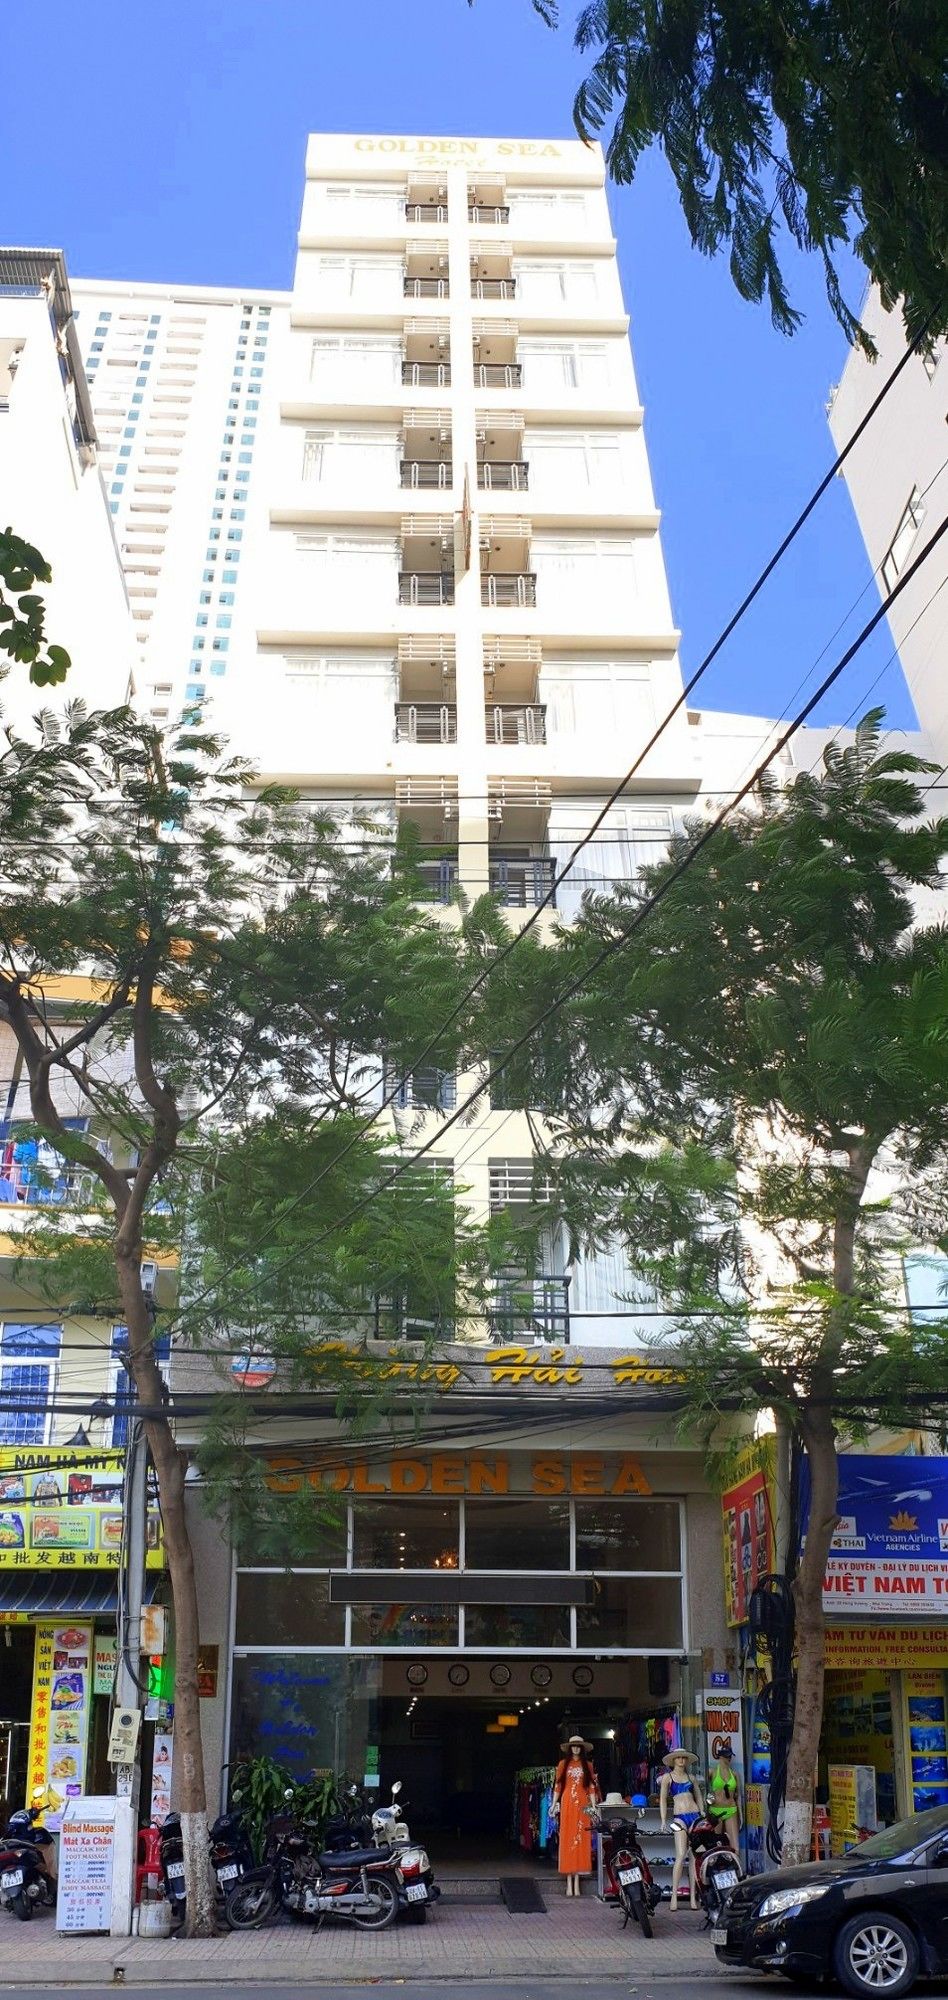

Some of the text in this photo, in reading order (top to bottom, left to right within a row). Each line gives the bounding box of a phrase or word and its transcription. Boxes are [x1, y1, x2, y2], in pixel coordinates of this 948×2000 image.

[354, 139, 561, 157] GOLDEN SEA
[15, 1454, 51, 1469] NAM
[261, 1451, 654, 1496] GOLDEN SEA
[844, 1539, 864, 1547] THAI
[866, 1533, 908, 1543] Vietnam
[909, 1563, 920, 1572] DU
[822, 1572, 867, 1597] VIỆT
[875, 1577, 926, 1594] NAM
[900, 1630, 918, 1641] DU
[38, 1678, 50, 1686] NAM
[715, 1674, 725, 1682] 57
[706, 1697, 734, 1706] SHOP
[63, 1823, 114, 1835] Blind Massage
[80, 1837, 91, 1846] Xa
